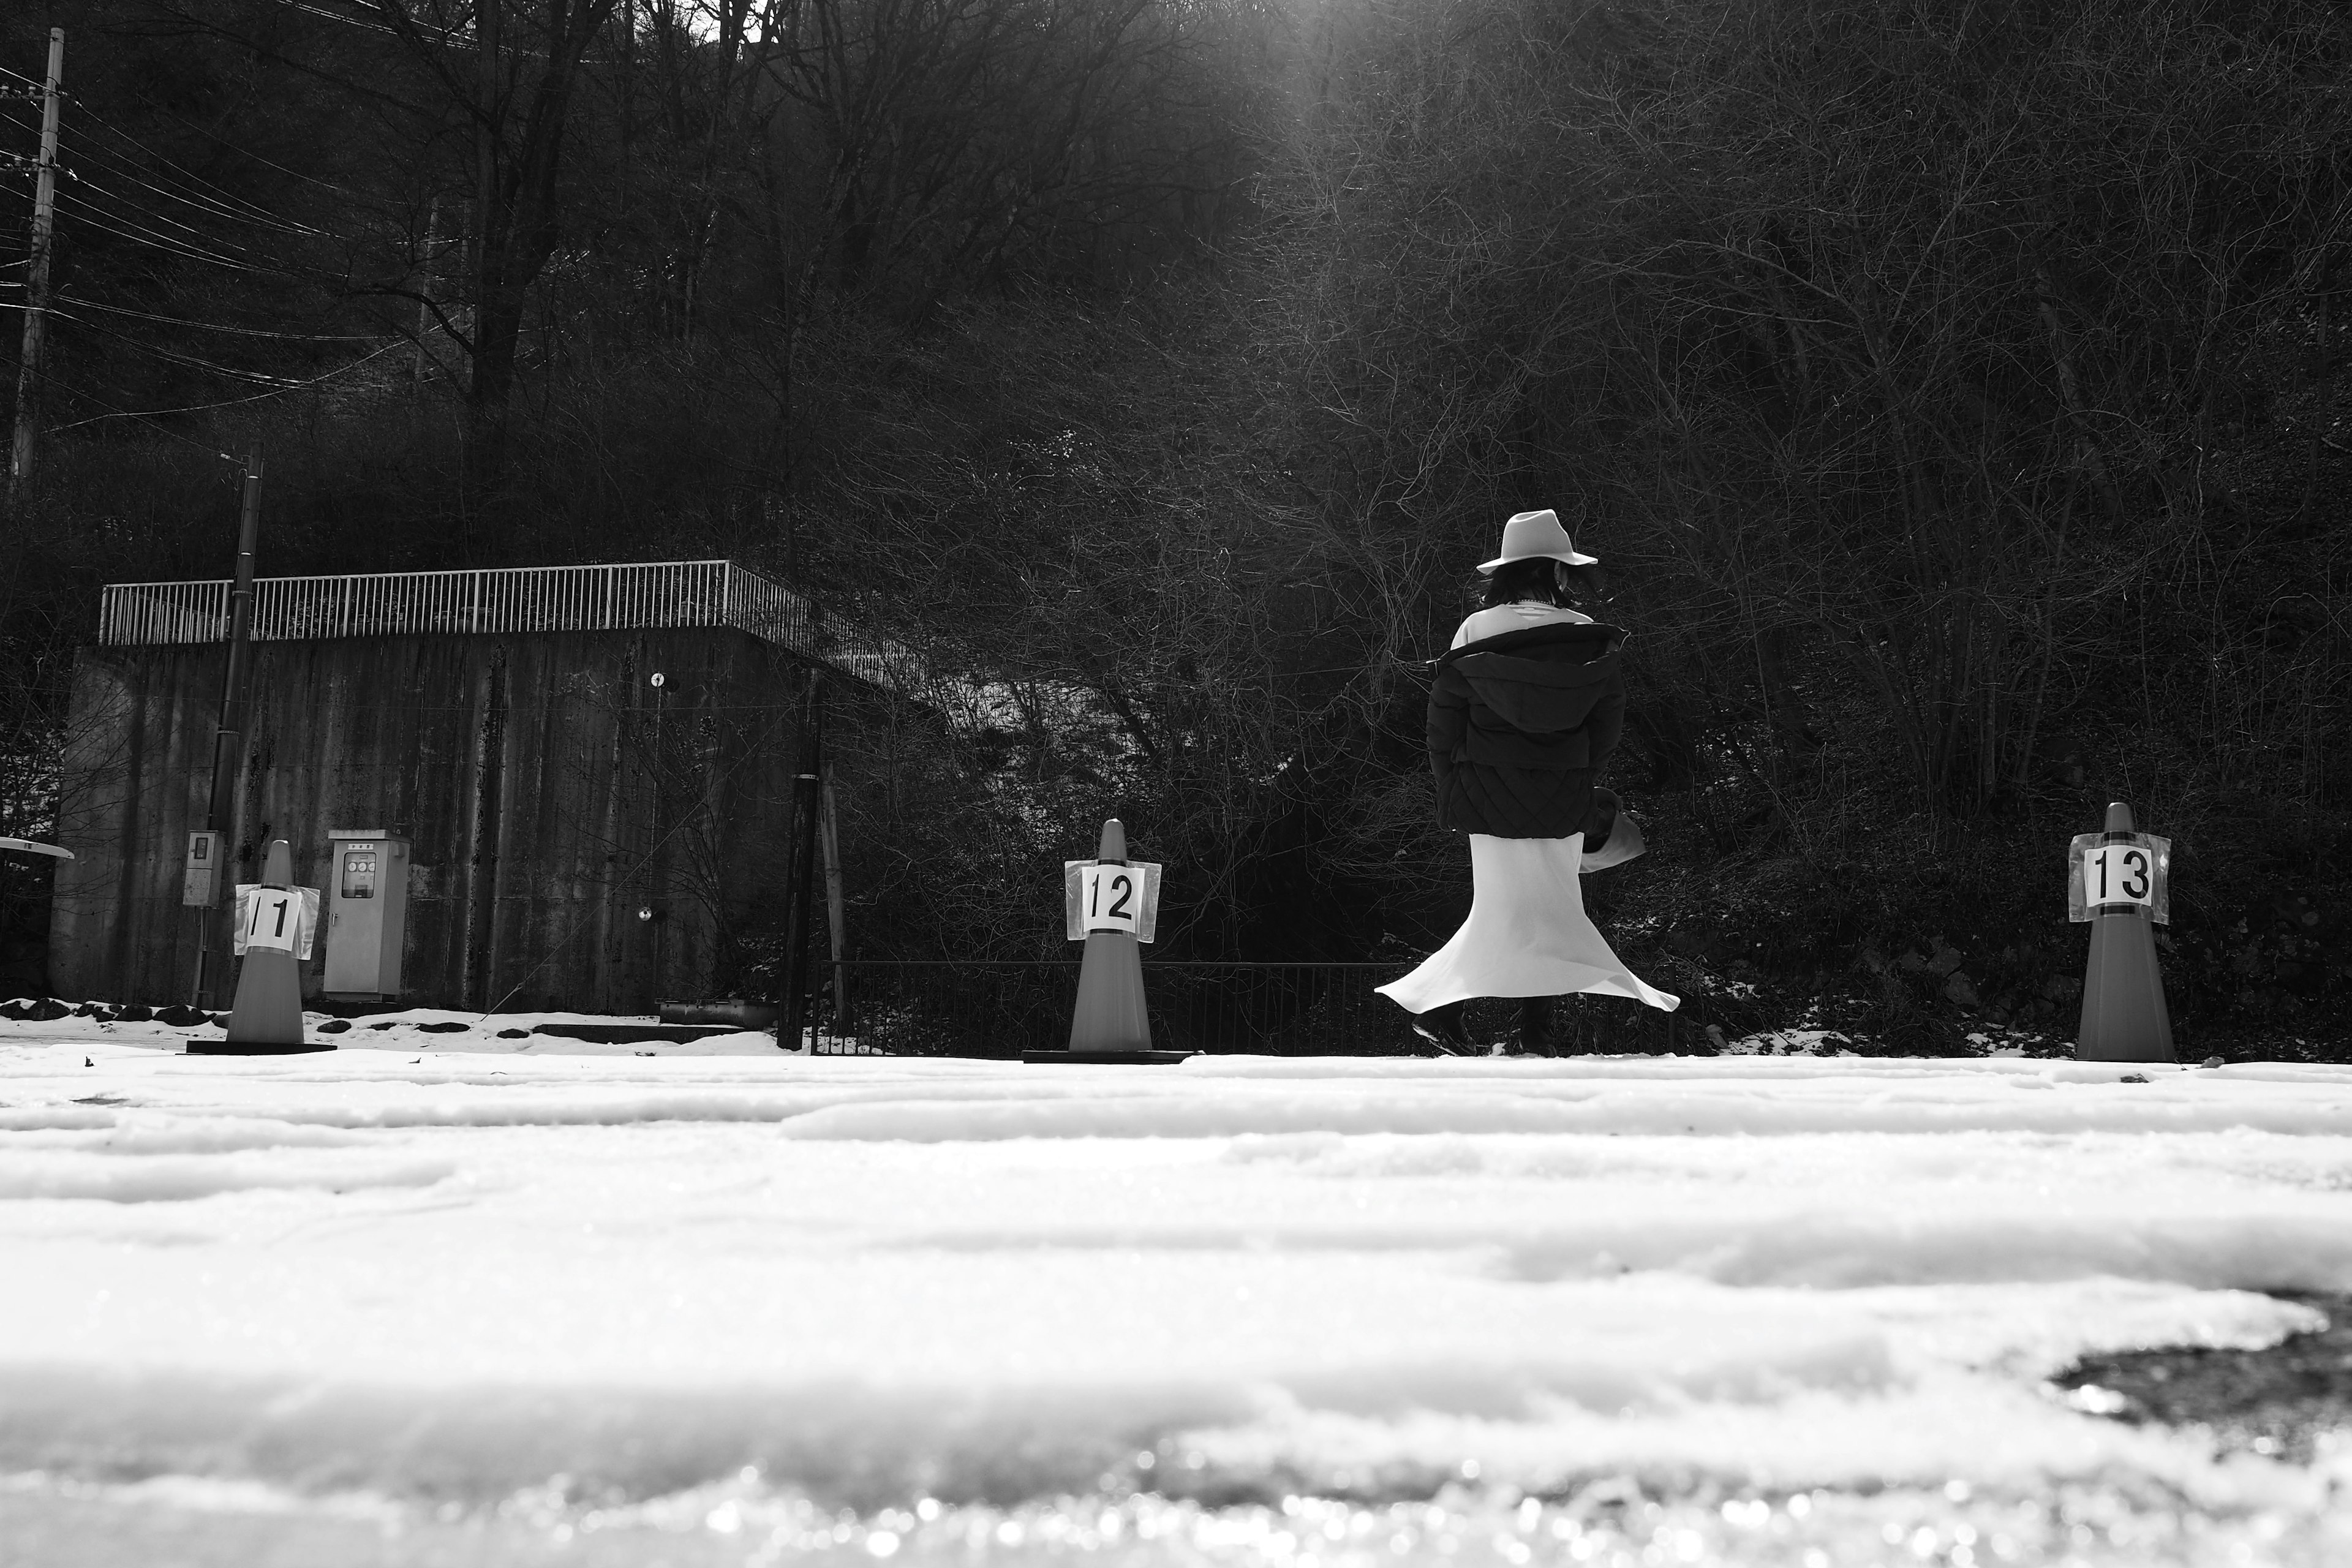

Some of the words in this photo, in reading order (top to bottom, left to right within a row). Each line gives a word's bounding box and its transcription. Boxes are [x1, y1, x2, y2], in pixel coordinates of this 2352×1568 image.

[1091, 873, 1132, 921] 12
[2095, 850, 2149, 899] 13
[251, 896, 288, 937] 11
